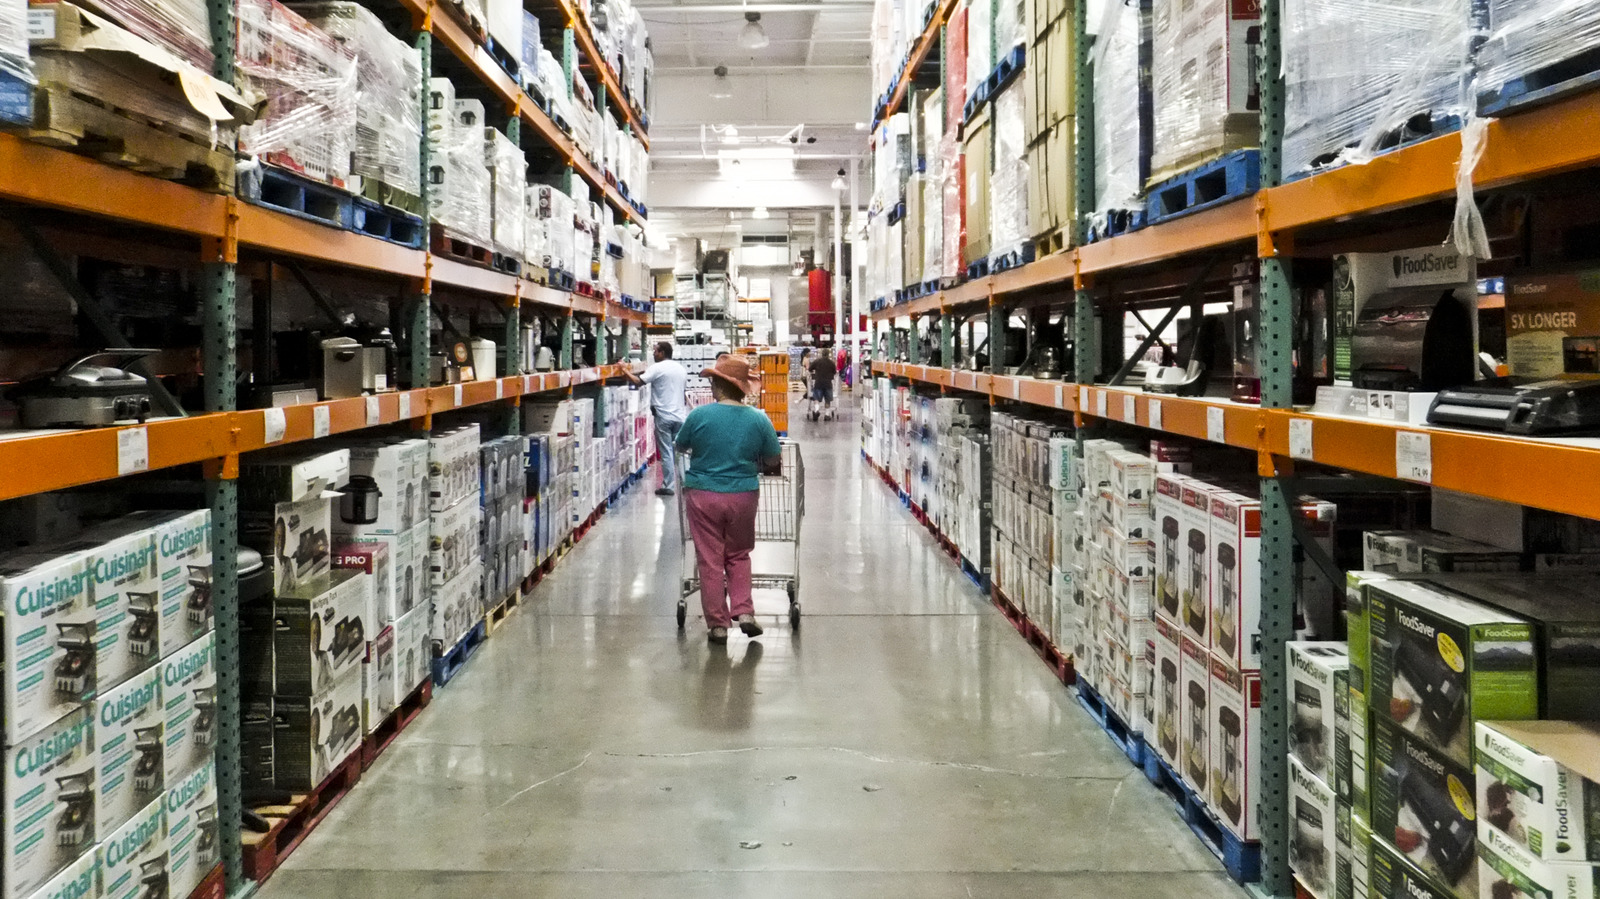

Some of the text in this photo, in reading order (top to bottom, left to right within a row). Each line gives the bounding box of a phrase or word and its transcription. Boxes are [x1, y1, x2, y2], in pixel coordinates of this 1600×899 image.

[1402, 253, 1459, 275] FoodSaver
[1513, 283, 1547, 295] FoodSaver
[1528, 311, 1577, 328] LONGER
[1060, 445, 1068, 488] Cuisinart
[160, 521, 212, 558] Cuisinart
[95, 543, 157, 585] Cuisinart
[345, 556, 366, 565] PRO
[15, 565, 96, 617] Cuisinart
[1398, 609, 1436, 638] FoodSaver
[1484, 628, 1530, 637] FoodSaver
[165, 637, 216, 687] Cuisinart
[1296, 651, 1328, 685] FoodSaver
[101, 673, 162, 727] Cuisinart
[15, 715, 95, 778] Cuisinart
[1406, 741, 1446, 776] FoodSaver
[1490, 738, 1525, 767] FoodSaver
[1297, 767, 1329, 808] FoodSaver
[1555, 771, 1569, 840] FoodSaver
[106, 800, 167, 868] Cuisinart
[1494, 836, 1532, 869] FoodSaver
